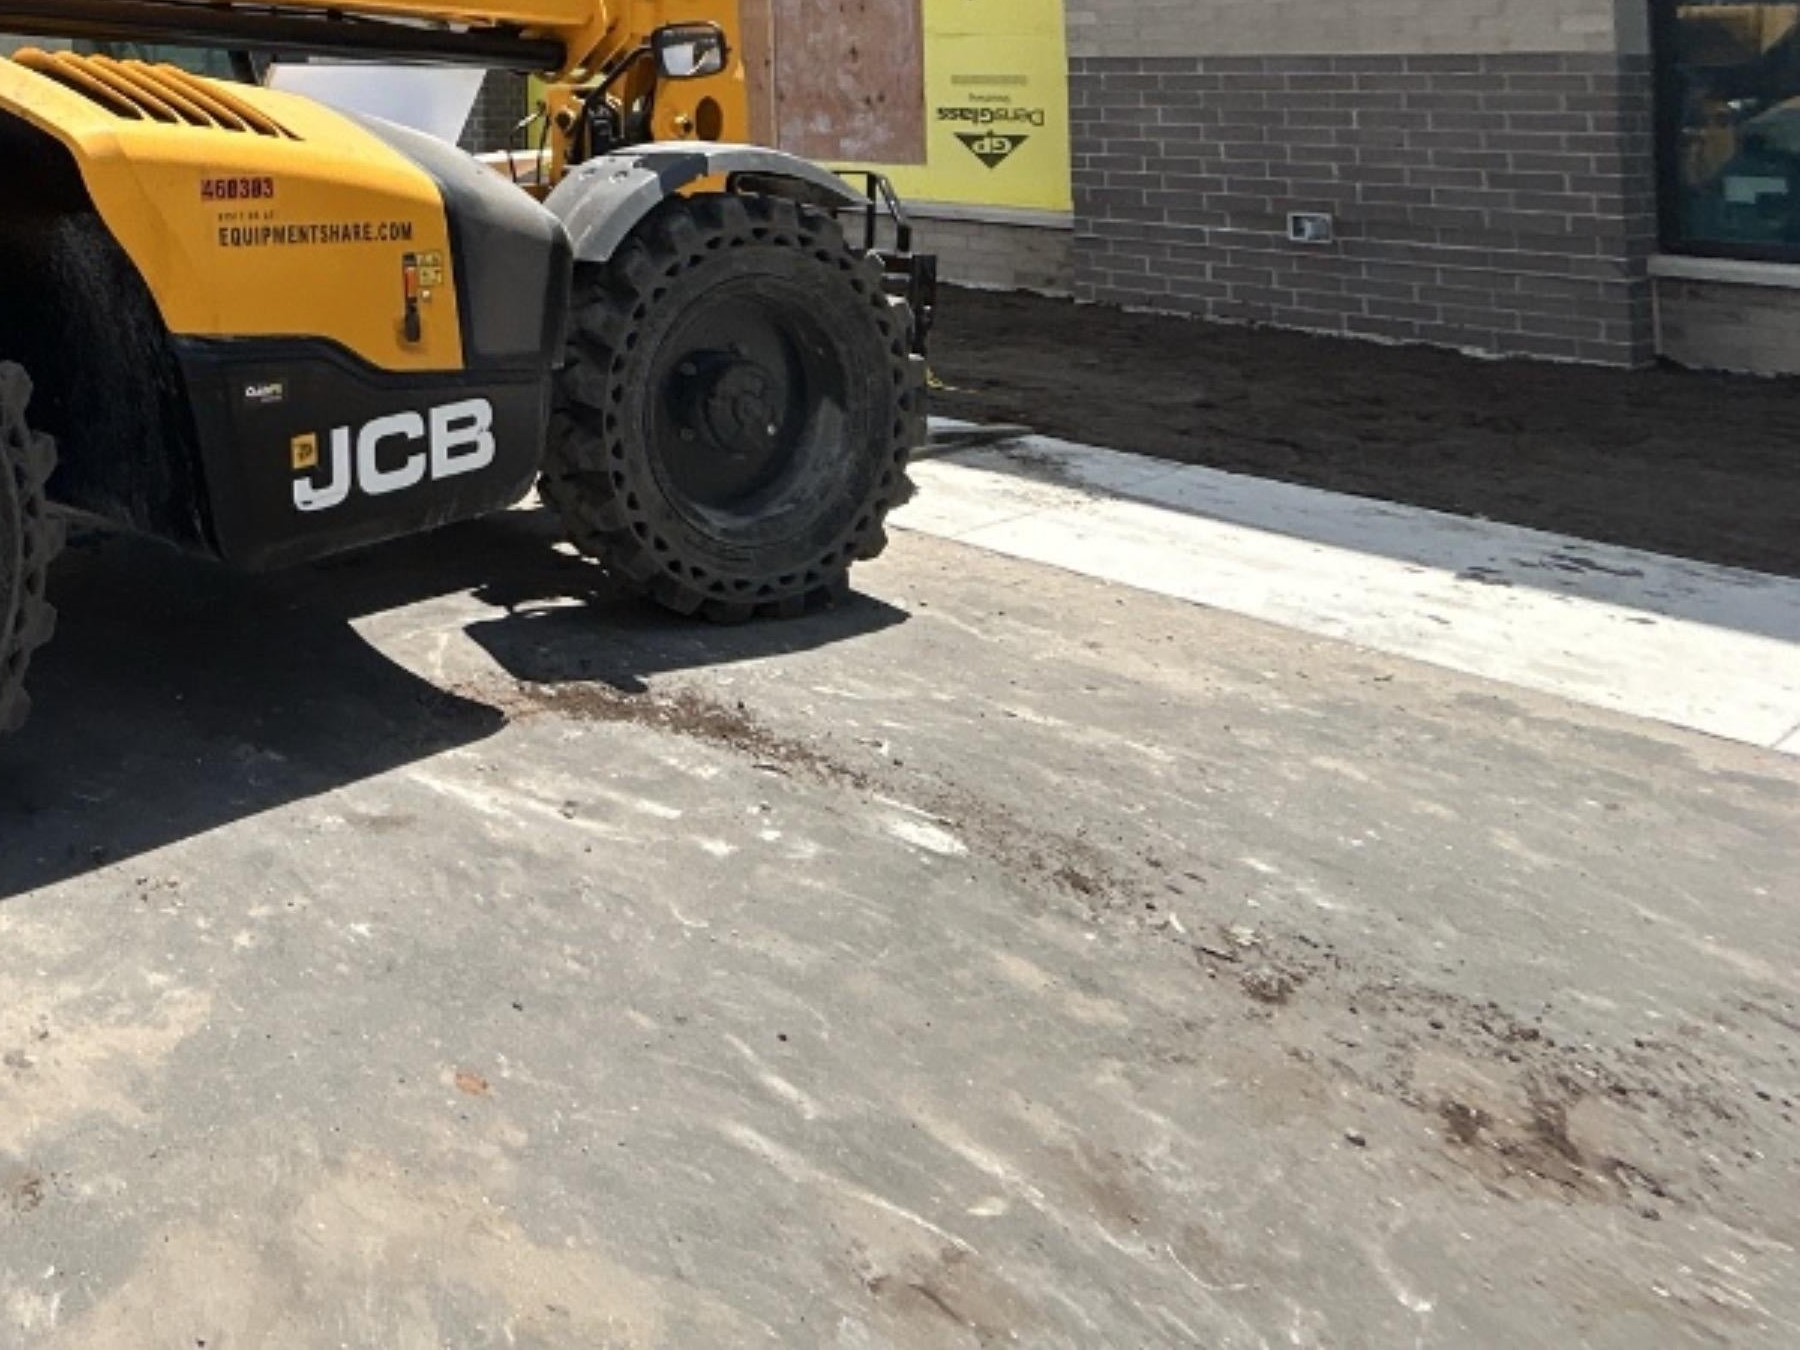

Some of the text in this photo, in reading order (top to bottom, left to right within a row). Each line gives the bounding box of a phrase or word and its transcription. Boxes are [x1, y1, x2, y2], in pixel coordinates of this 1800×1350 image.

[937, 107, 1045, 126] DensGlass
[218, 222, 413, 246] EQUIPMENTSHARE.COM
[292, 398, 496, 512] JCB
